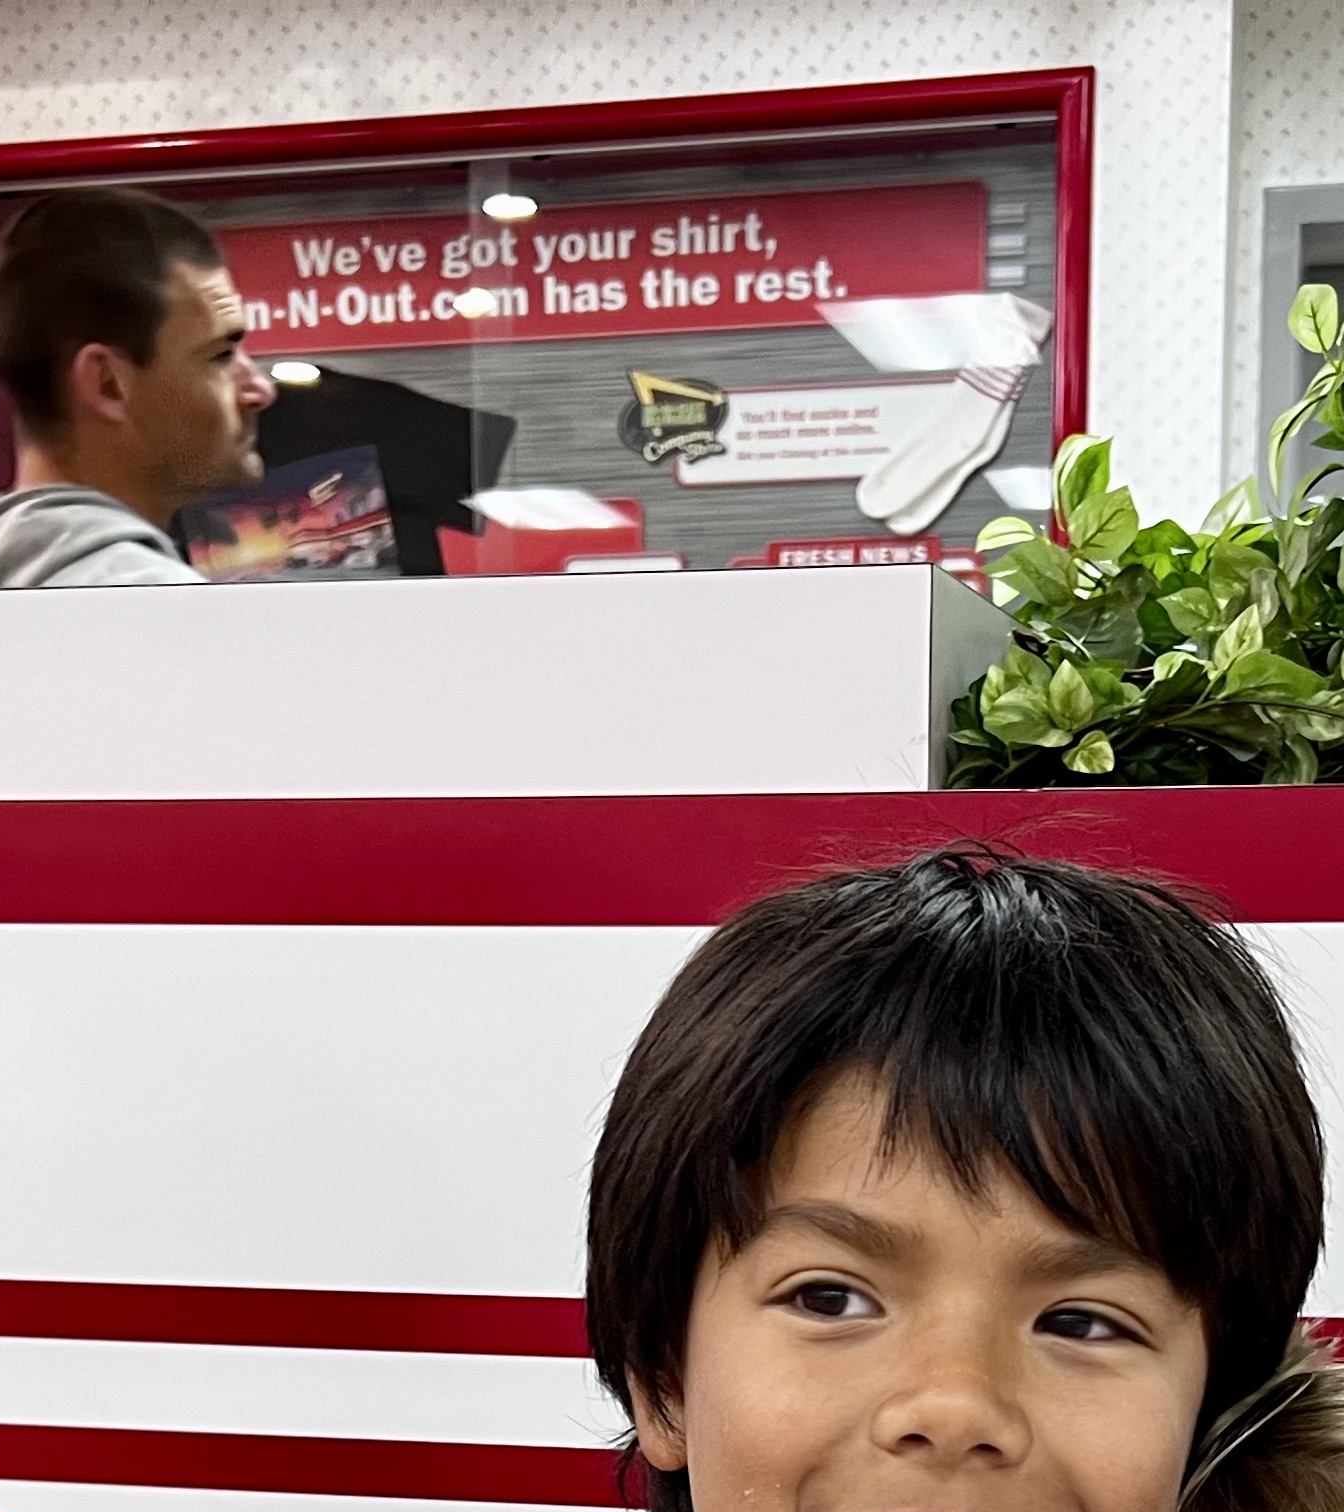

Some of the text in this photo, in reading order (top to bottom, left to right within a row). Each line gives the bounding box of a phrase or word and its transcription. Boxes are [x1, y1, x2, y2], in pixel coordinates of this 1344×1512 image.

[291, 211, 778, 279] We've got your shirt,
[243, 255, 849, 332] n-N-Out.cm has the rest.
